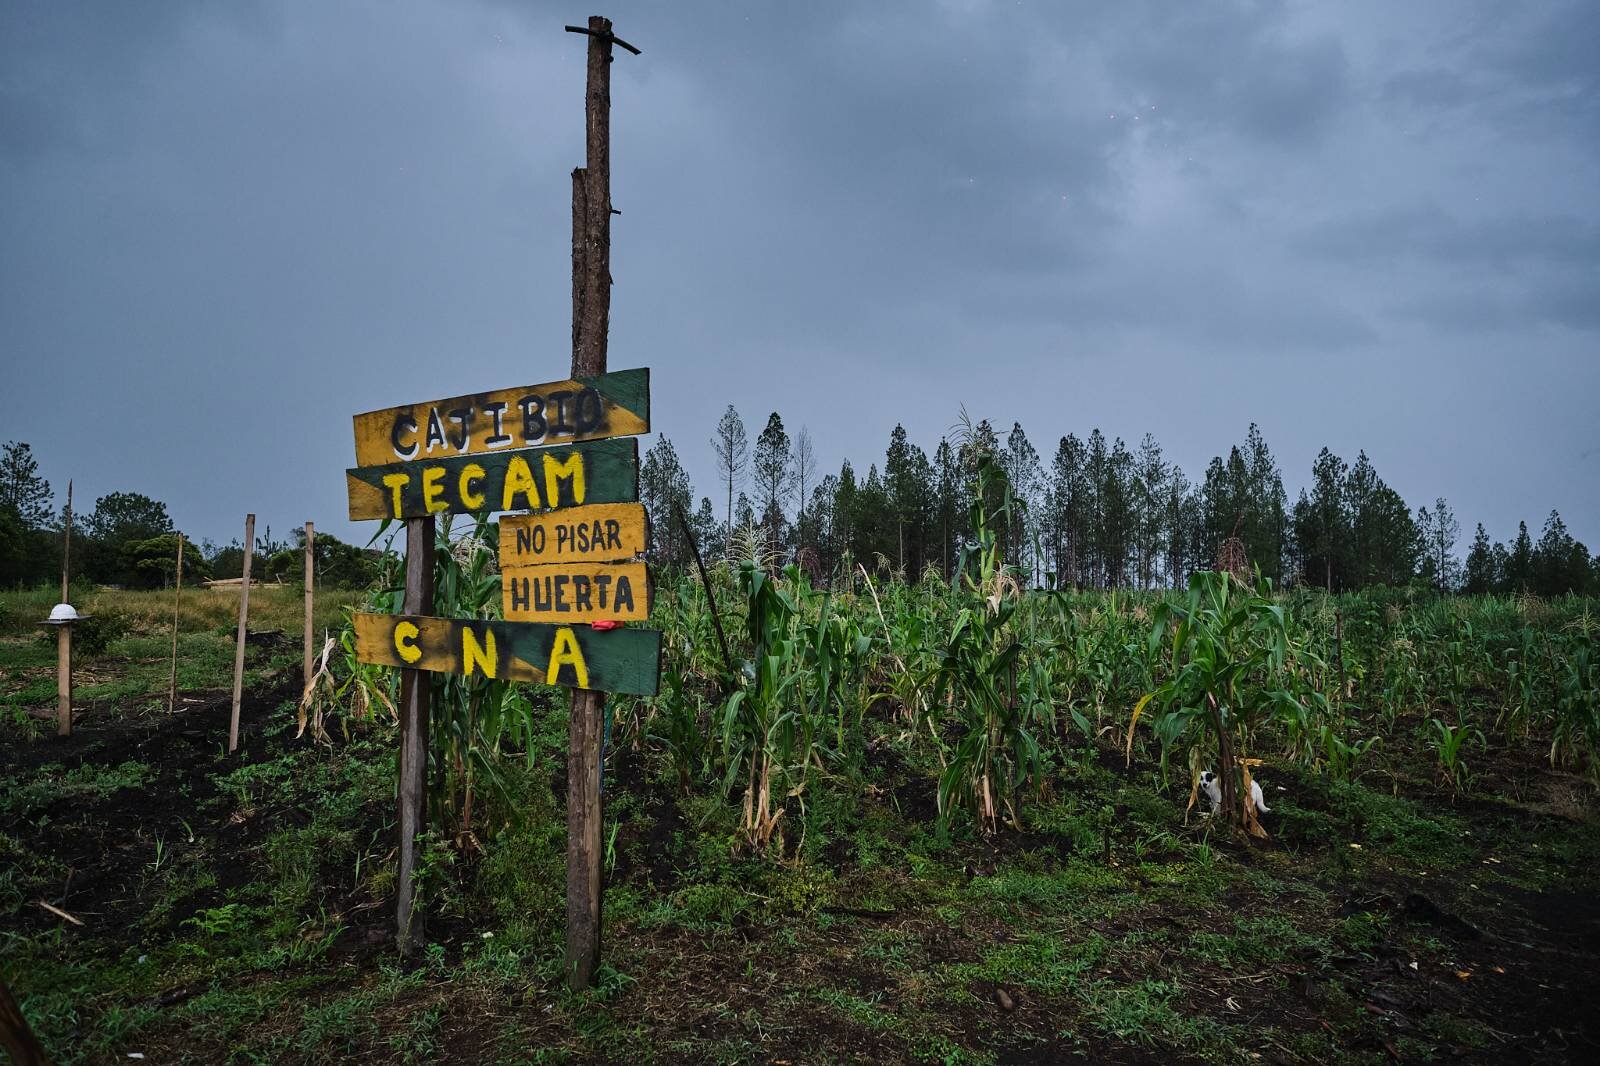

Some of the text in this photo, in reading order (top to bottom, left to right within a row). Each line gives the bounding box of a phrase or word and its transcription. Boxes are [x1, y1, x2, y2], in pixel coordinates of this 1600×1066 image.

[391, 388, 604, 461] CAJIBIO
[383, 452, 586, 519] TECAM
[517, 519, 623, 555] NO PISAR
[511, 574, 635, 613] HUERTA
